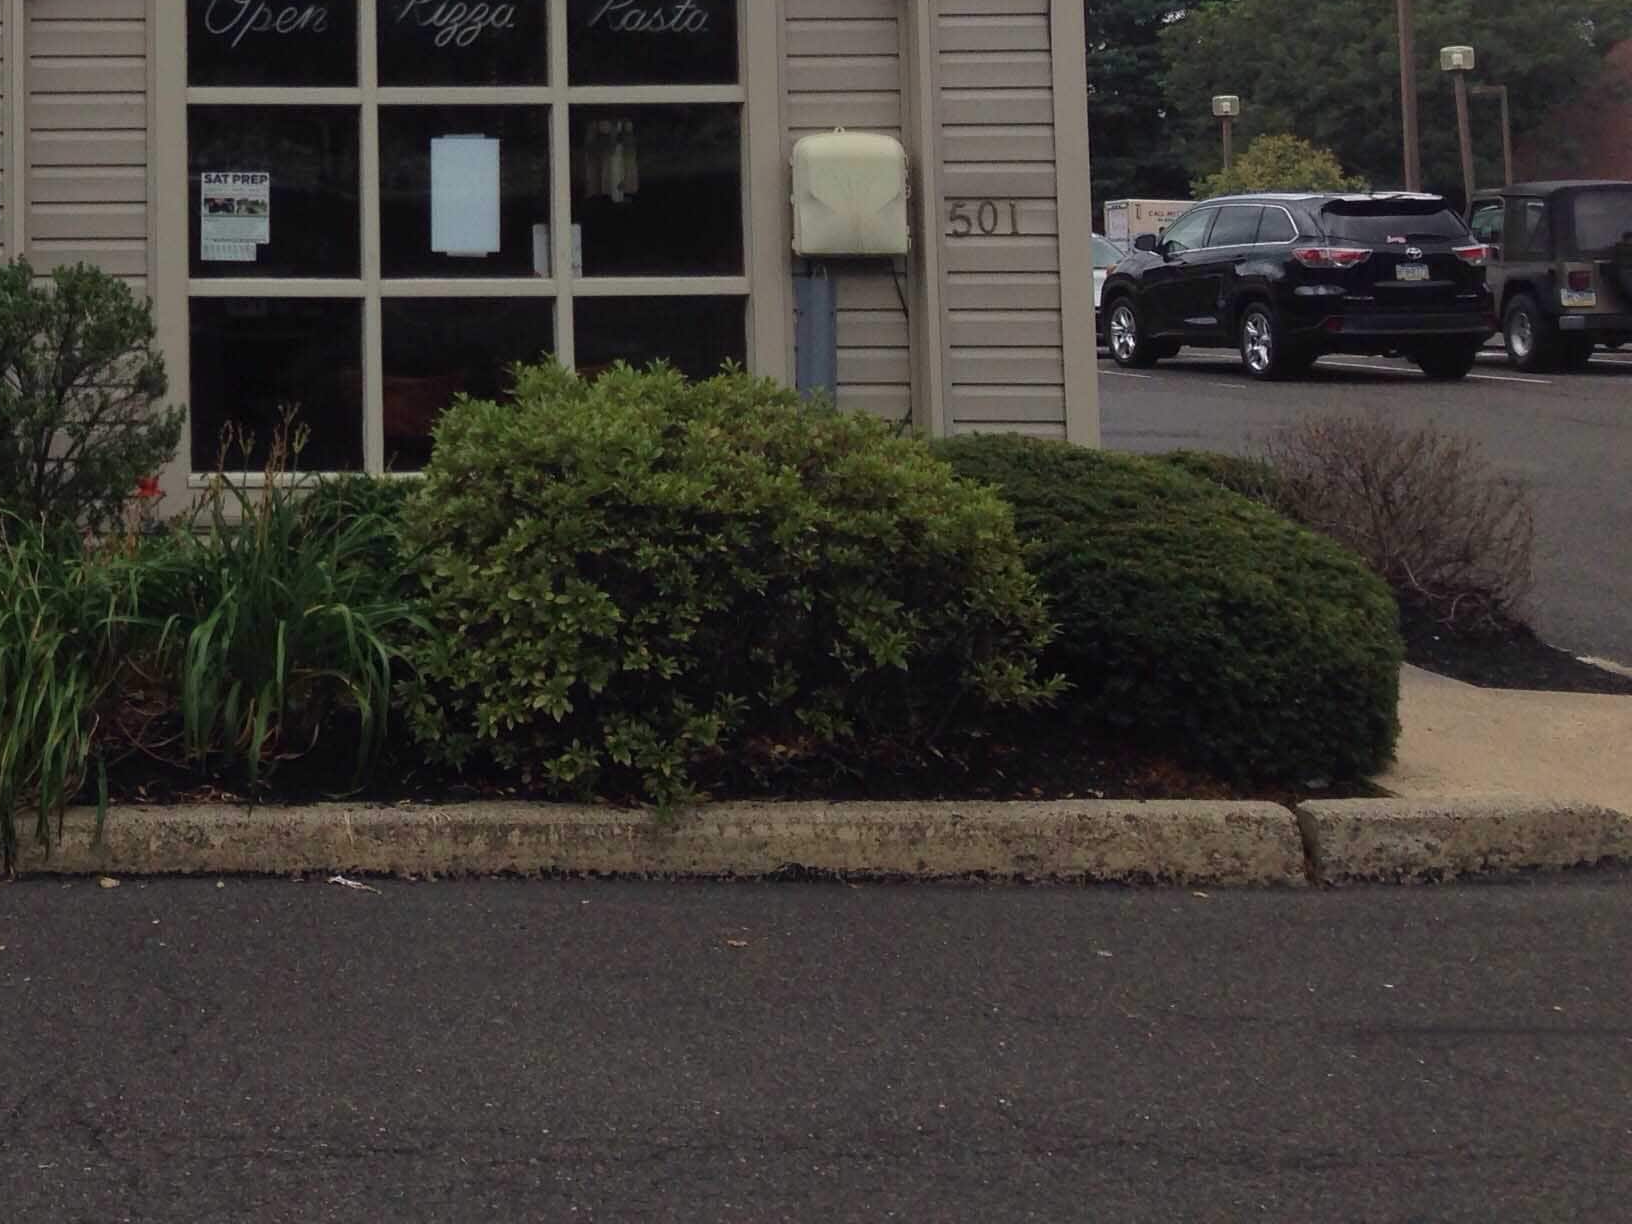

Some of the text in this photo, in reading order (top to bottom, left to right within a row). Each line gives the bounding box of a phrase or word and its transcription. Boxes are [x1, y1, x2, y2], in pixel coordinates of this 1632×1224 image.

[204, 174, 268, 184] SAT PREP
[949, 200, 1019, 237] 501
